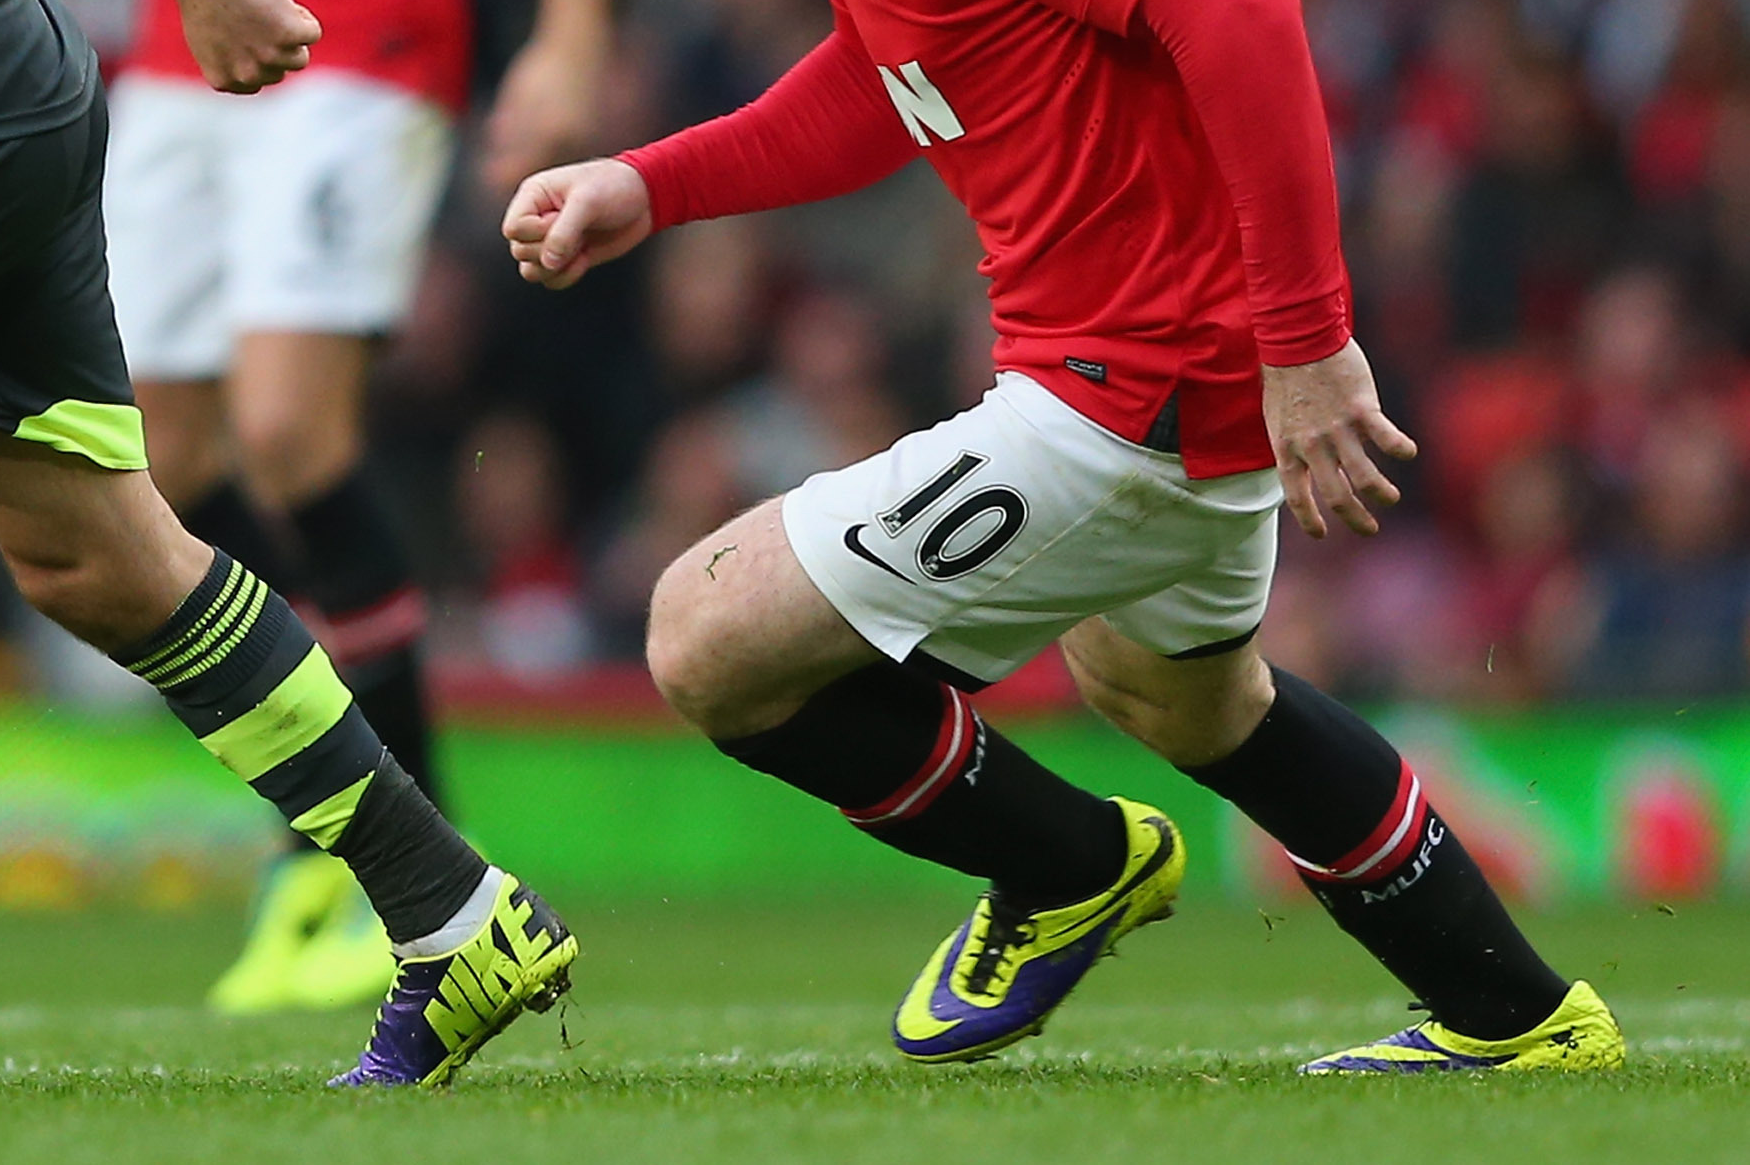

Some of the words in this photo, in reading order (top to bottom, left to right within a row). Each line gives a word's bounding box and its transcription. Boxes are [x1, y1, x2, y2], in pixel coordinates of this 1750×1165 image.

[875, 449, 1030, 582] 10
[1362, 817, 1446, 905] MUFC
[423, 873, 553, 1052] NIKE
